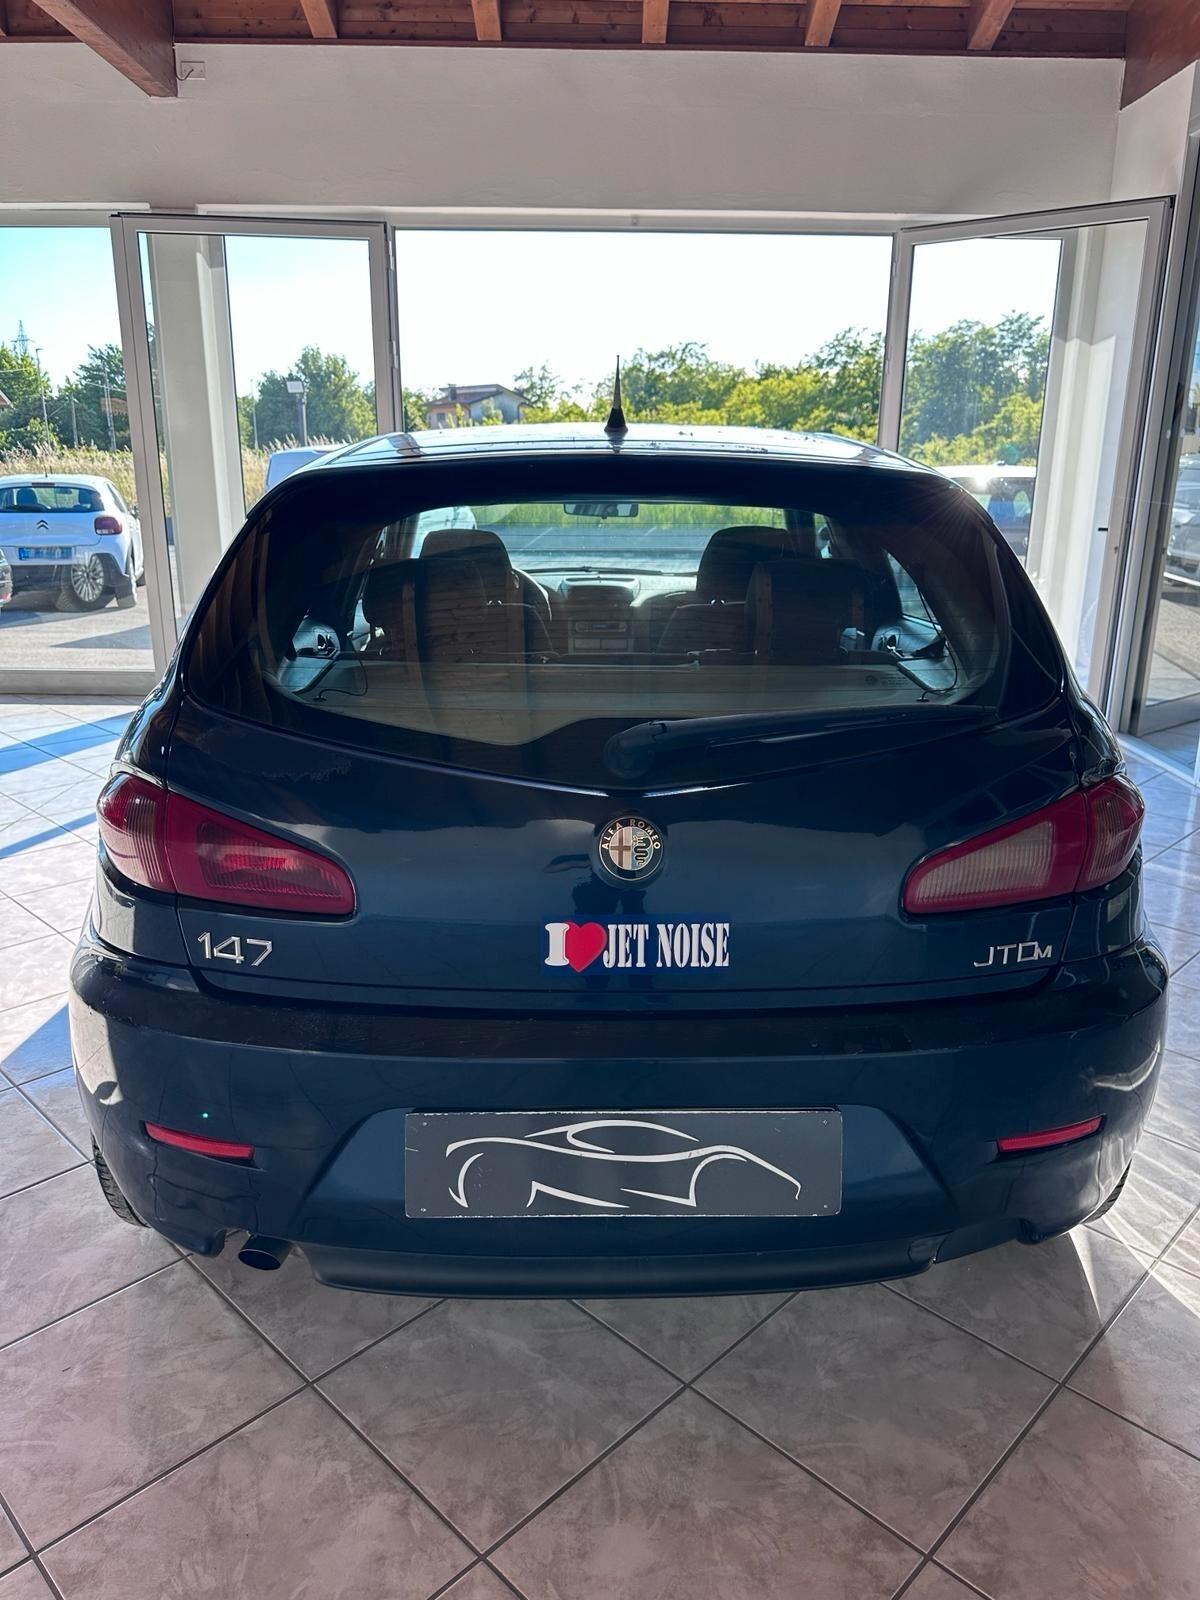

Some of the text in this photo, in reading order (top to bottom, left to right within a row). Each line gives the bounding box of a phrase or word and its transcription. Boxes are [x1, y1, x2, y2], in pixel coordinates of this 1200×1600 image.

[601, 819, 661, 850] ALFA ROMEO
[197, 931, 273, 967] 147
[544, 922, 730, 968] I JET NOISE
